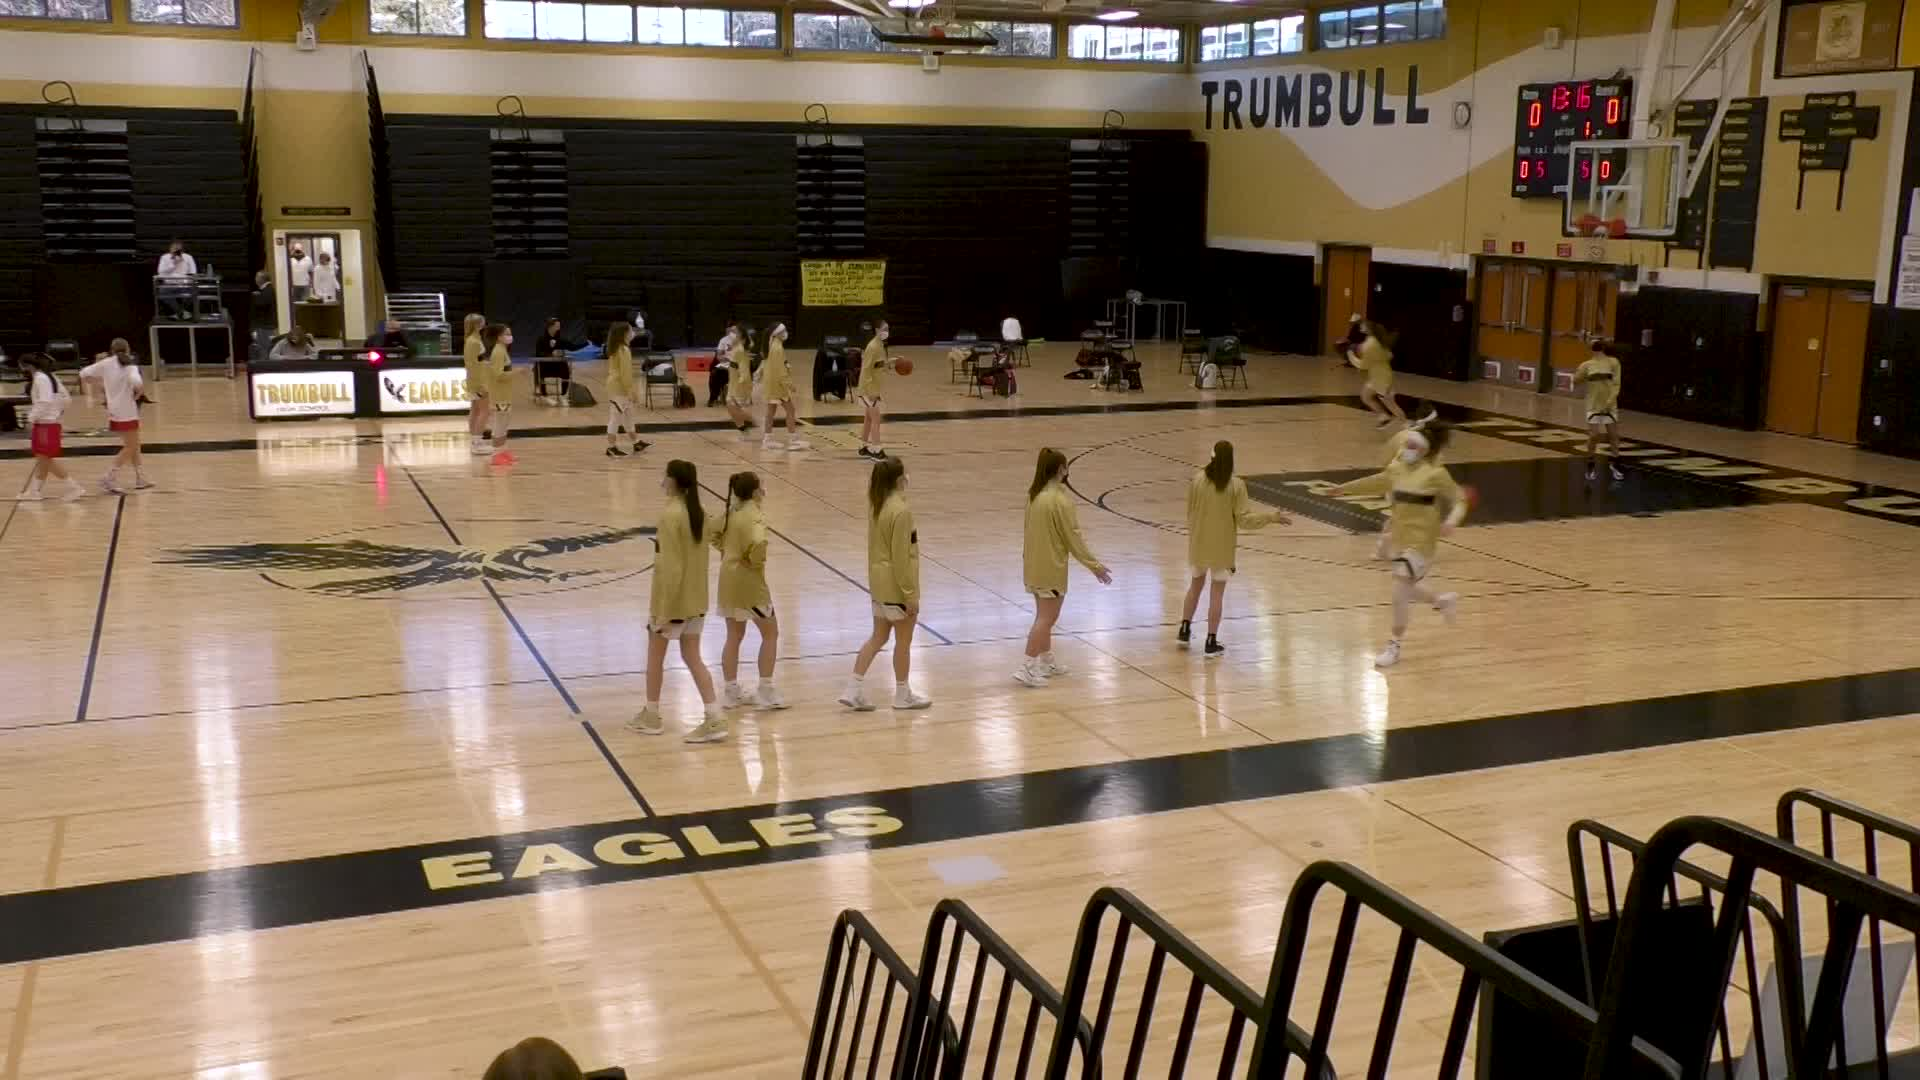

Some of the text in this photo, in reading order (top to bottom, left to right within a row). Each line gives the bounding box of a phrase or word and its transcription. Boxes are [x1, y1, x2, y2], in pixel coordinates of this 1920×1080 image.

[1201, 64, 1429, 130] TRUMBULL
[1530, 102, 1541, 127] 0
[1607, 98, 1619, 125] 0
[1520, 161, 1529, 178] 0
[1602, 161, 1611, 178] 0
[256, 383, 353, 405] TRUMBULL
[421, 806, 904, 890] EAGLES
